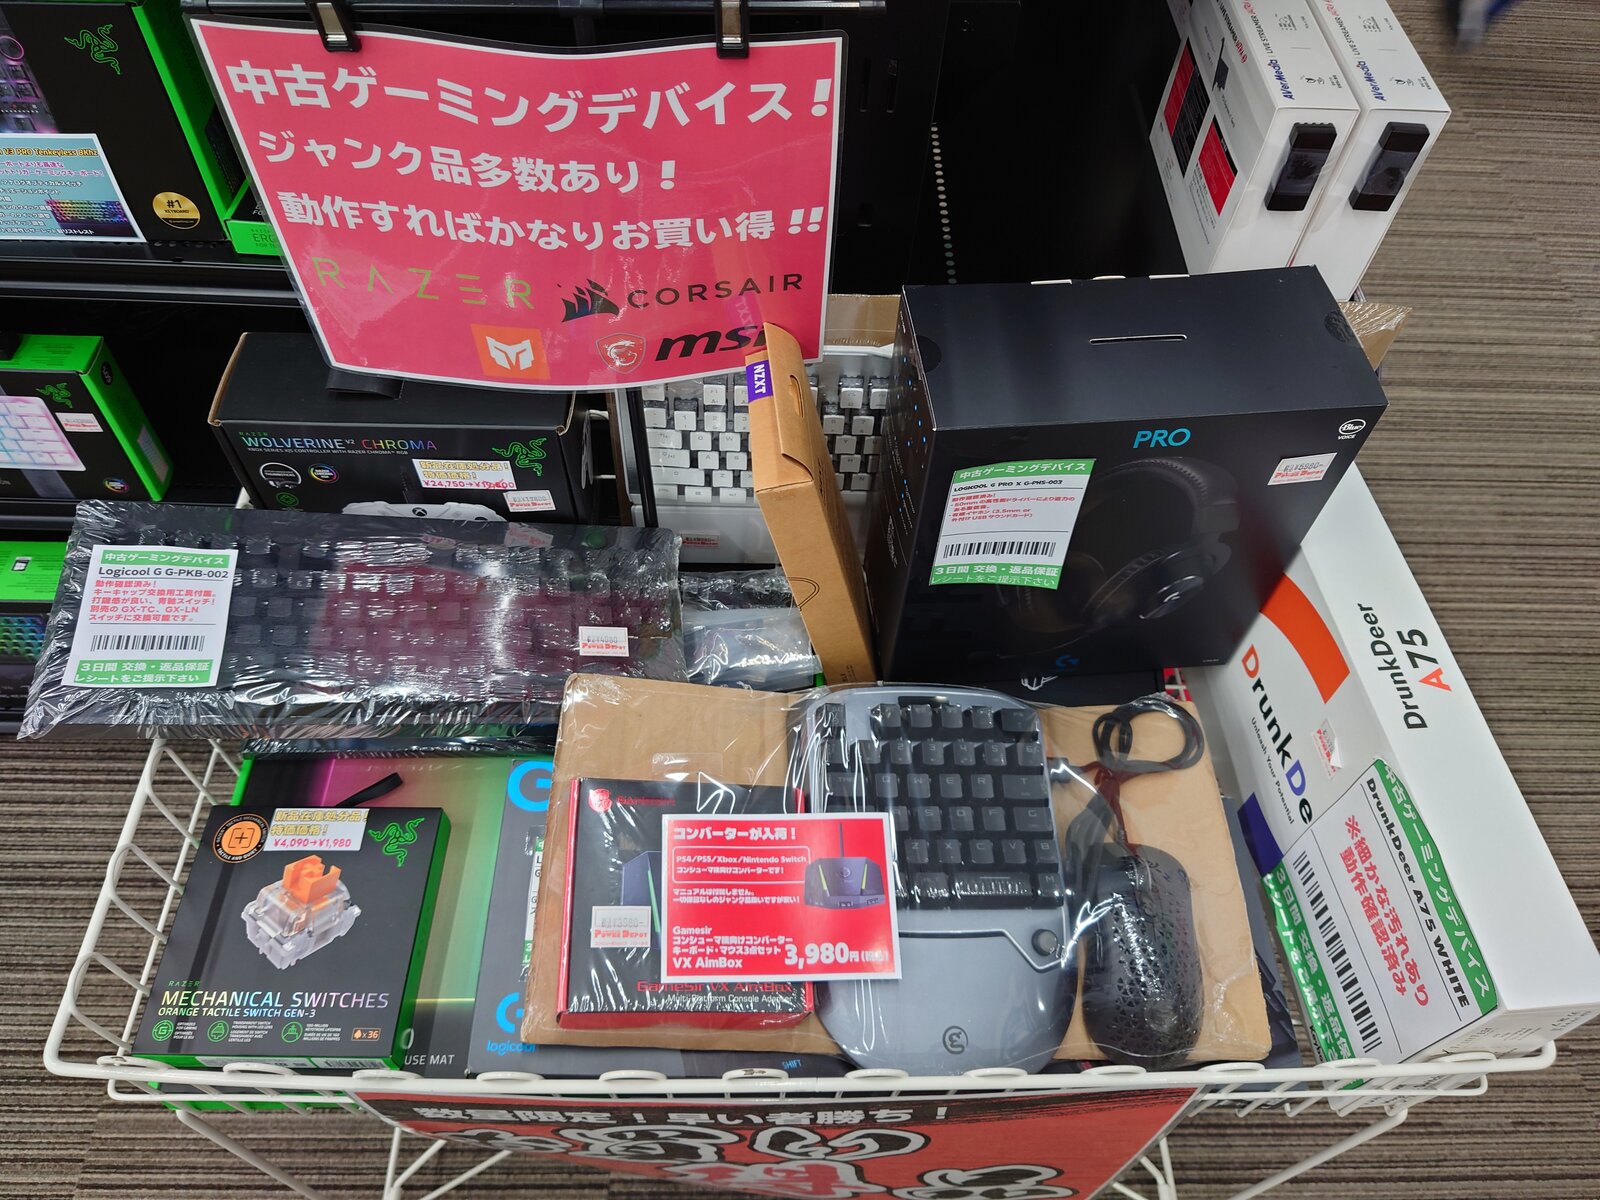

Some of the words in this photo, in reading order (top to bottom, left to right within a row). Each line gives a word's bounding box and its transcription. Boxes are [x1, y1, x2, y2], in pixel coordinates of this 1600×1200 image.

[1268, 59, 1295, 100] AVerMedia
[1356, 60, 1387, 101] AVerMedia
[225, 60, 833, 133] 中古ゲーミングデバイス！
[258, 129, 676, 193] ジャンク品多数あり！
[311, 257, 533, 310] RAZER
[628, 272, 803, 310] CORSAIR
[753, 363, 767, 395] NZXT
[241, 436, 346, 449] WOLVERINE
[361, 439, 438, 450] CHROMA
[1132, 428, 1191, 449] PRO
[960, 462, 1086, 479] 中古ゲーミングデバイス
[105, 552, 224, 565] 中古ゲーミングデバイス
[98, 567, 150, 577] Logicool
[153, 567, 162, 576] G
[165, 568, 229, 578] G-PKB-002
[973, 565, 1059, 577] 交換・返品保証
[931, 574, 1055, 586] レシートをご提示下さい
[121, 662, 210, 672] 交換・返品保証
[1357, 602, 1427, 730] DrunkDeer
[1401, 627, 1453, 692] A75
[75, 674, 199, 683] レシートをご提示下さい
[1241, 644, 1313, 825] DrunkDe
[1251, 717, 1267, 754] Unleash
[1266, 755, 1277, 780] Your
[1276, 781, 1295, 825] Potential
[275, 810, 369, 822] 新品在庫処分品！
[270, 823, 329, 836] 特価価格！
[673, 827, 797, 840] コンバーターが入荷！
[781, 855, 807, 863] Switch
[1384, 764, 1487, 998] 中古ゲーミングデバイス
[1366, 777, 1415, 884] DrunkDeer
[1413, 888, 1437, 932] A75
[1434, 935, 1470, 1008] WHITE
[1344, 814, 1430, 1007] ※細かな汚れあり
[1339, 845, 1408, 997] 動作確認済み
[672, 926, 712, 935] Gamesir
[673, 957, 693, 968] VX
[695, 957, 743, 968] AimBox
[160, 990, 284, 1007] MECHANICAL
[291, 991, 390, 1008] SWITCHES
[728, 994, 759, 1002] Console
[158, 1007, 199, 1016] ORANGE
[202, 1007, 241, 1017] TACTILE
[243, 1008, 281, 1017] SWITCH
[283, 1008, 316, 1018] GEN-3
[486, 1040, 536, 1054] logicool
[1309, 1025, 1325, 1063] Keybo
[430, 1054, 455, 1065] MAT
